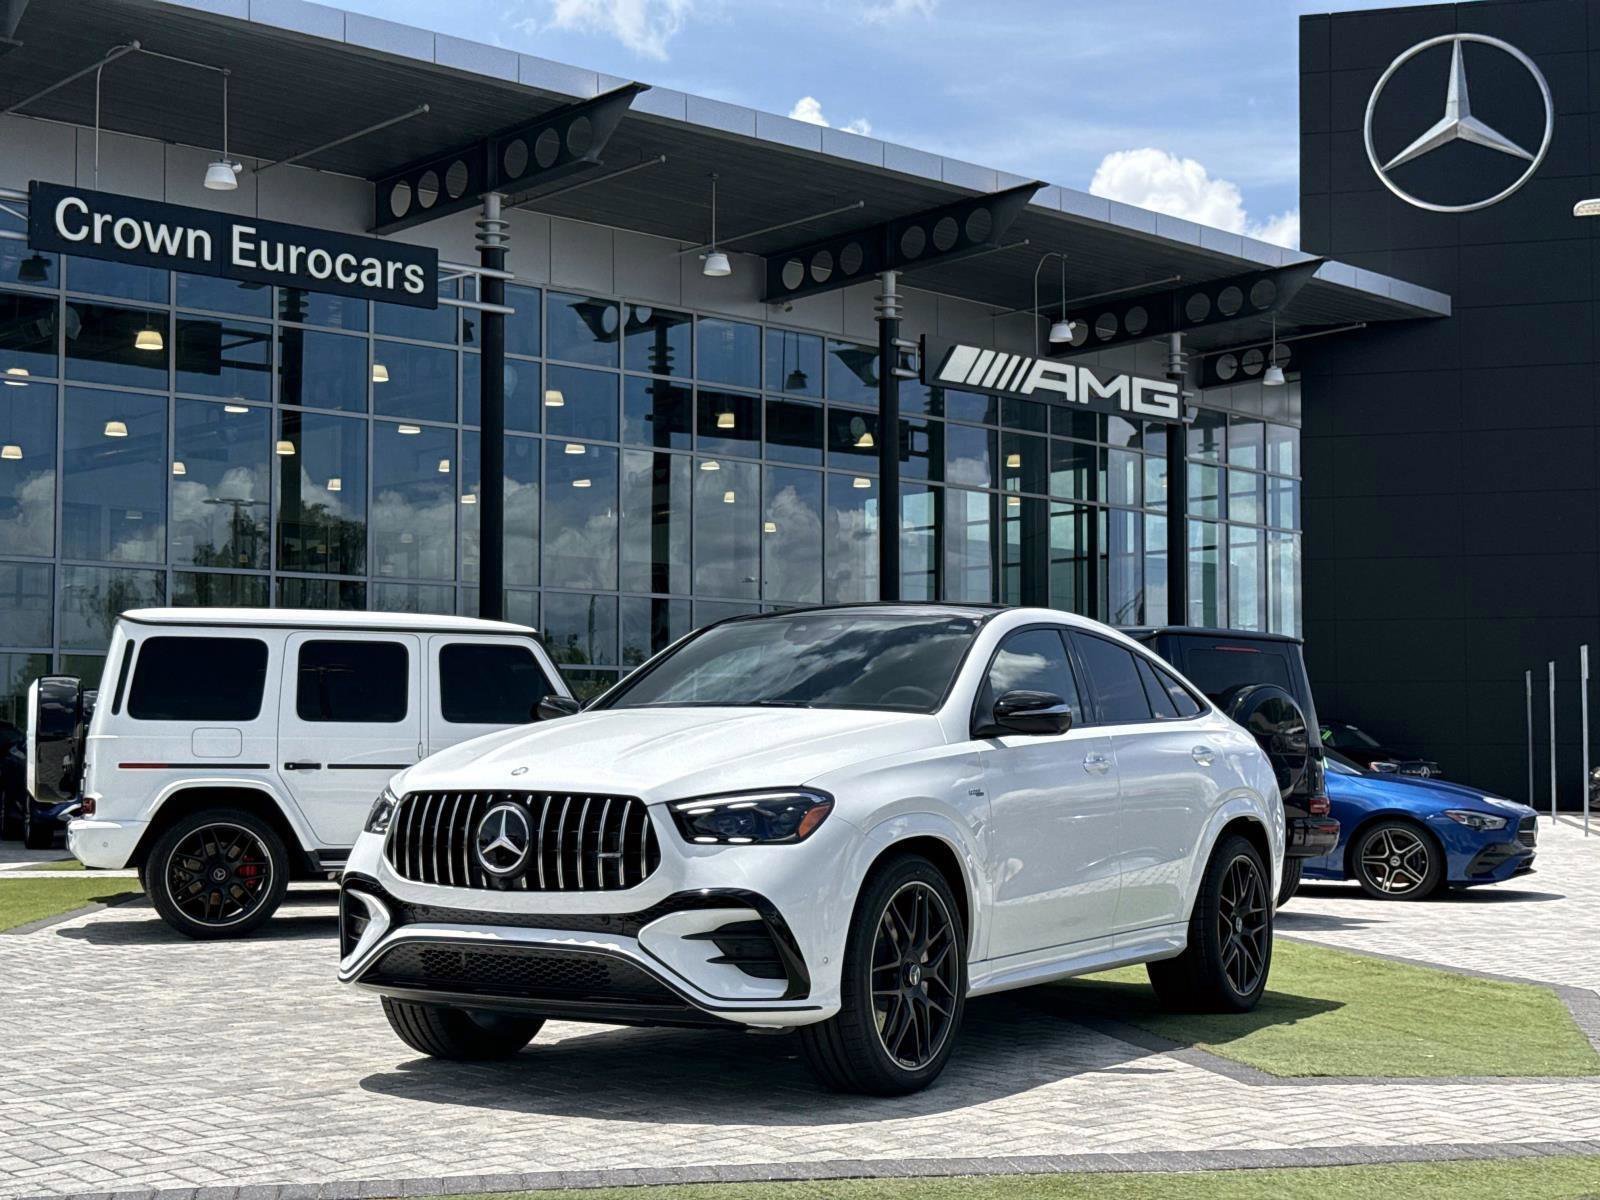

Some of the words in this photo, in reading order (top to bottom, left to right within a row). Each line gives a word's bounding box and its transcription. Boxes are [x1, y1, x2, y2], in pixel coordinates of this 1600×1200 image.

[55, 197, 212, 261] Crown
[232, 224, 425, 294] Eurocars
[1020, 359, 1179, 419] AMG
